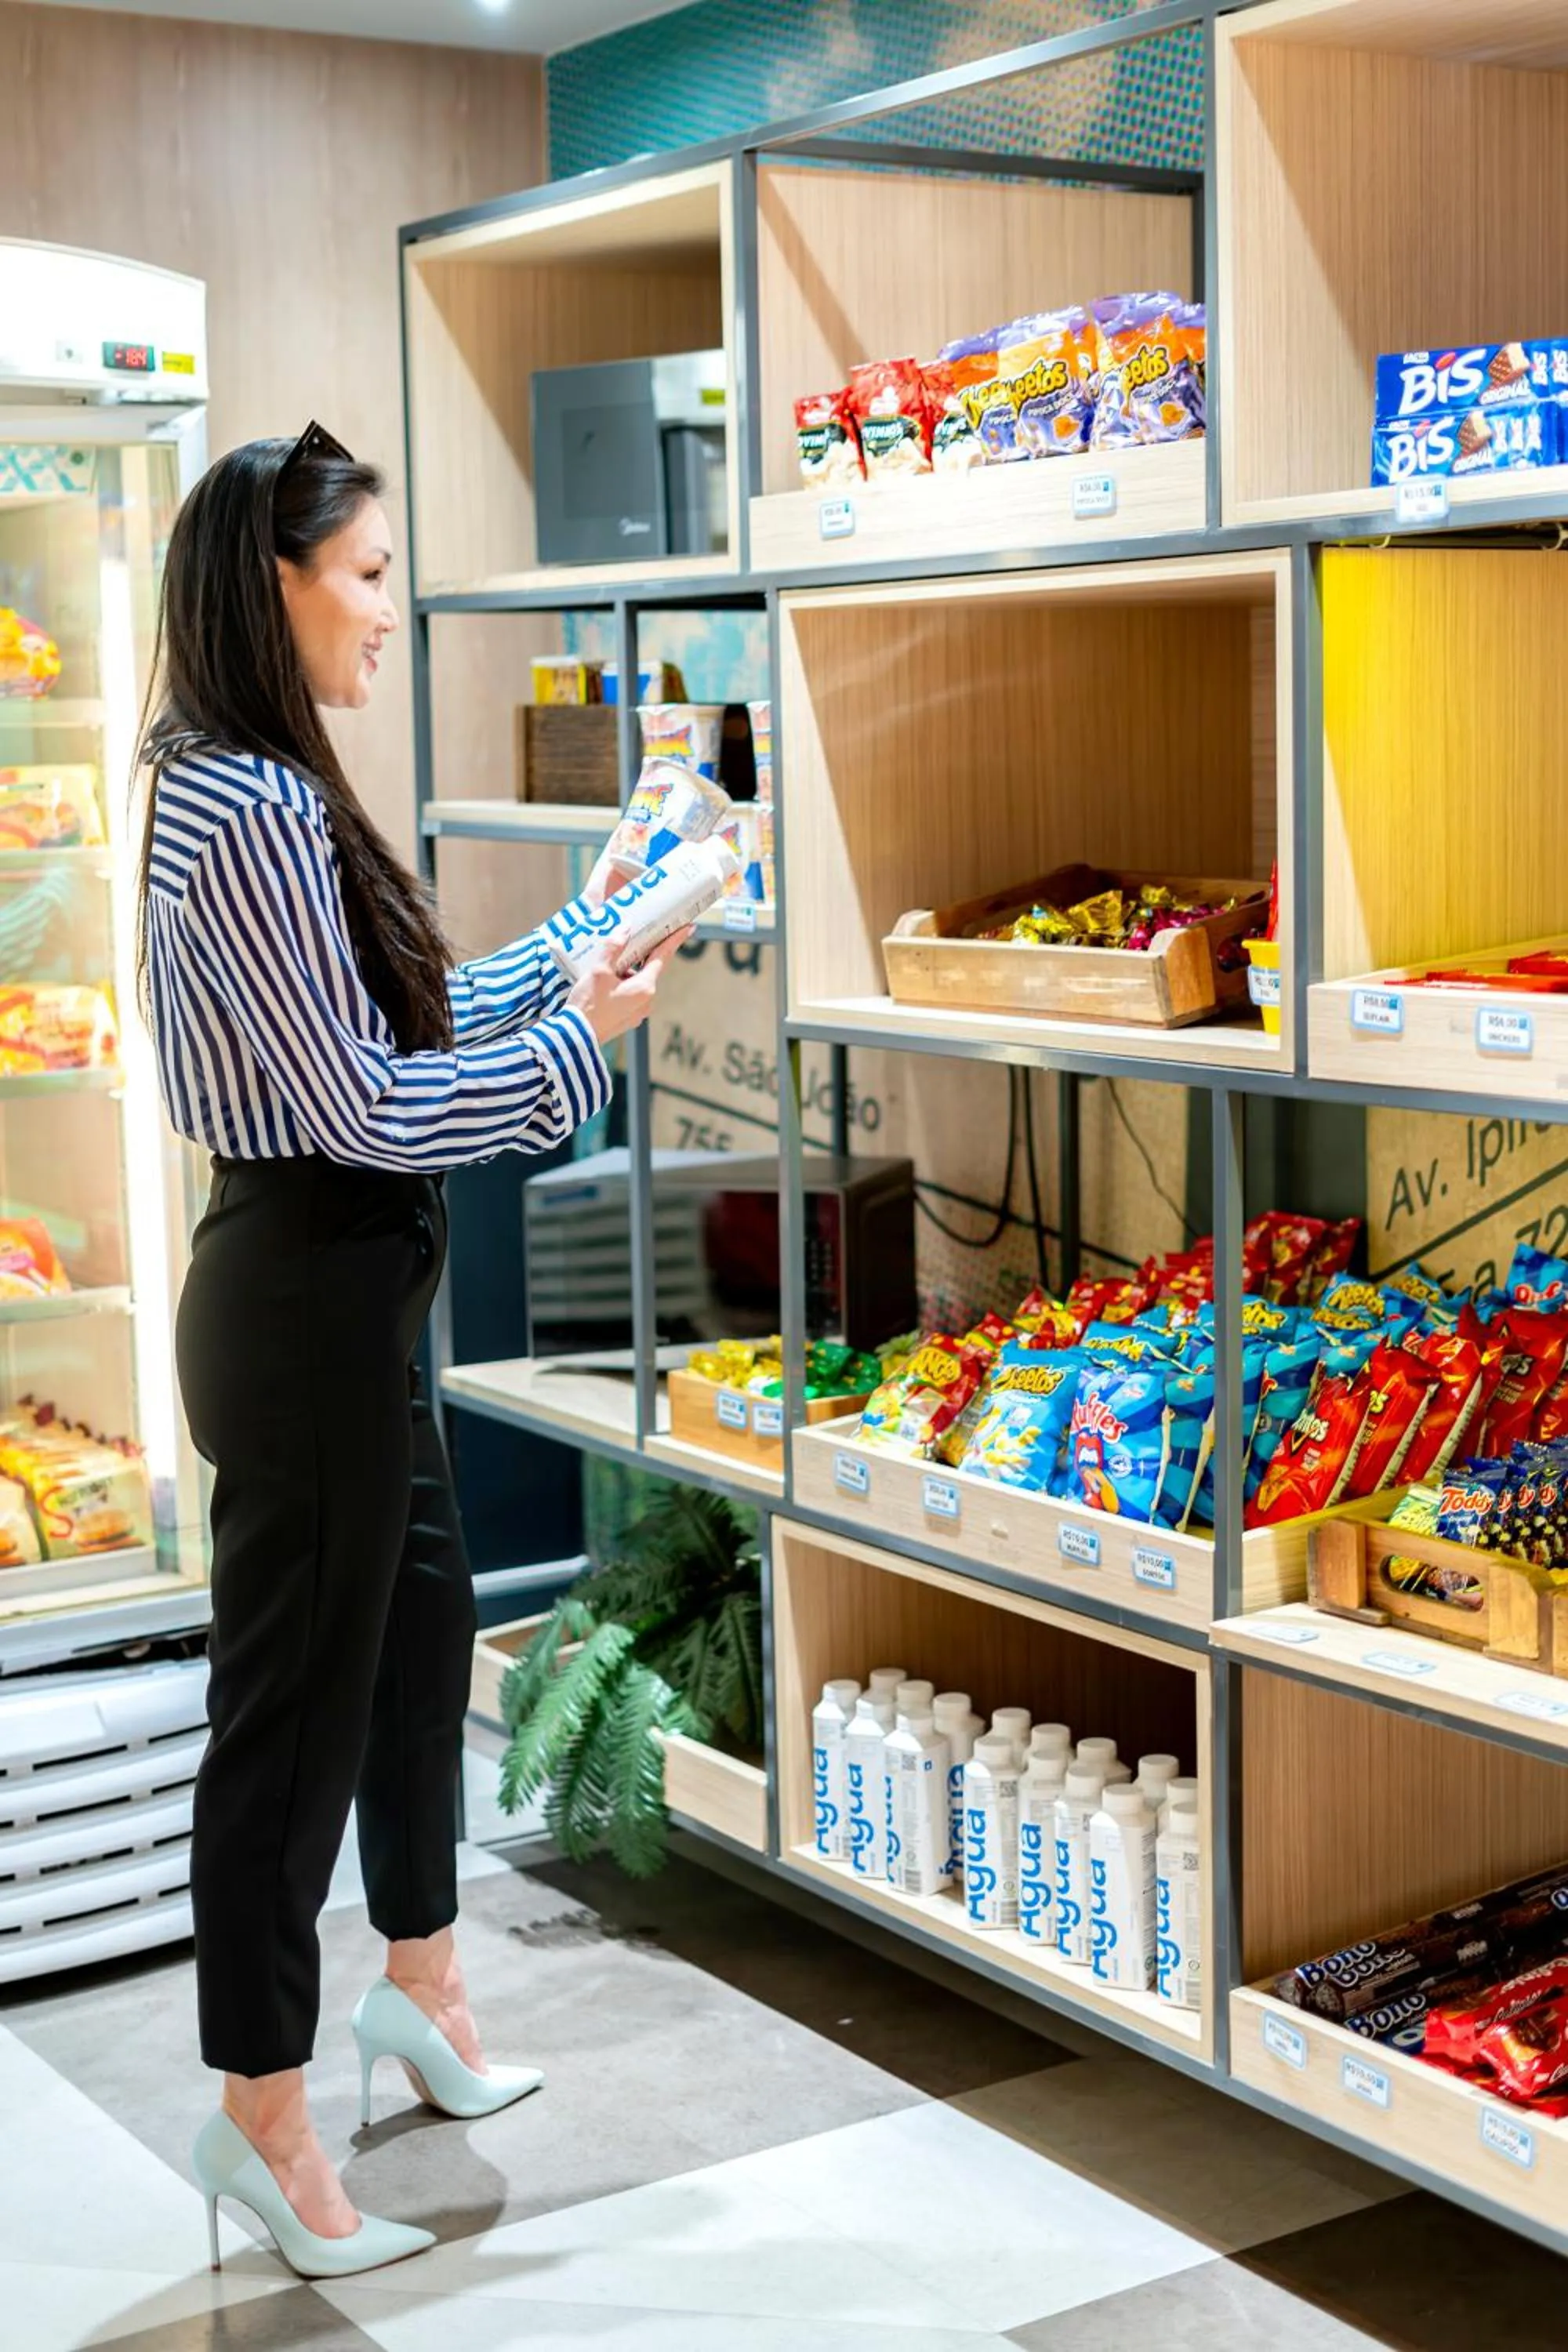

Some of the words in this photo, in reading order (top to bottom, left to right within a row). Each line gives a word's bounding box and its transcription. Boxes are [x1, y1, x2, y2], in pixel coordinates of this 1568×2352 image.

[662, 1023, 711, 1074] Av.
[1385, 1157, 1448, 1231] Av.
[1439, 1486, 1493, 1516] Toddy
